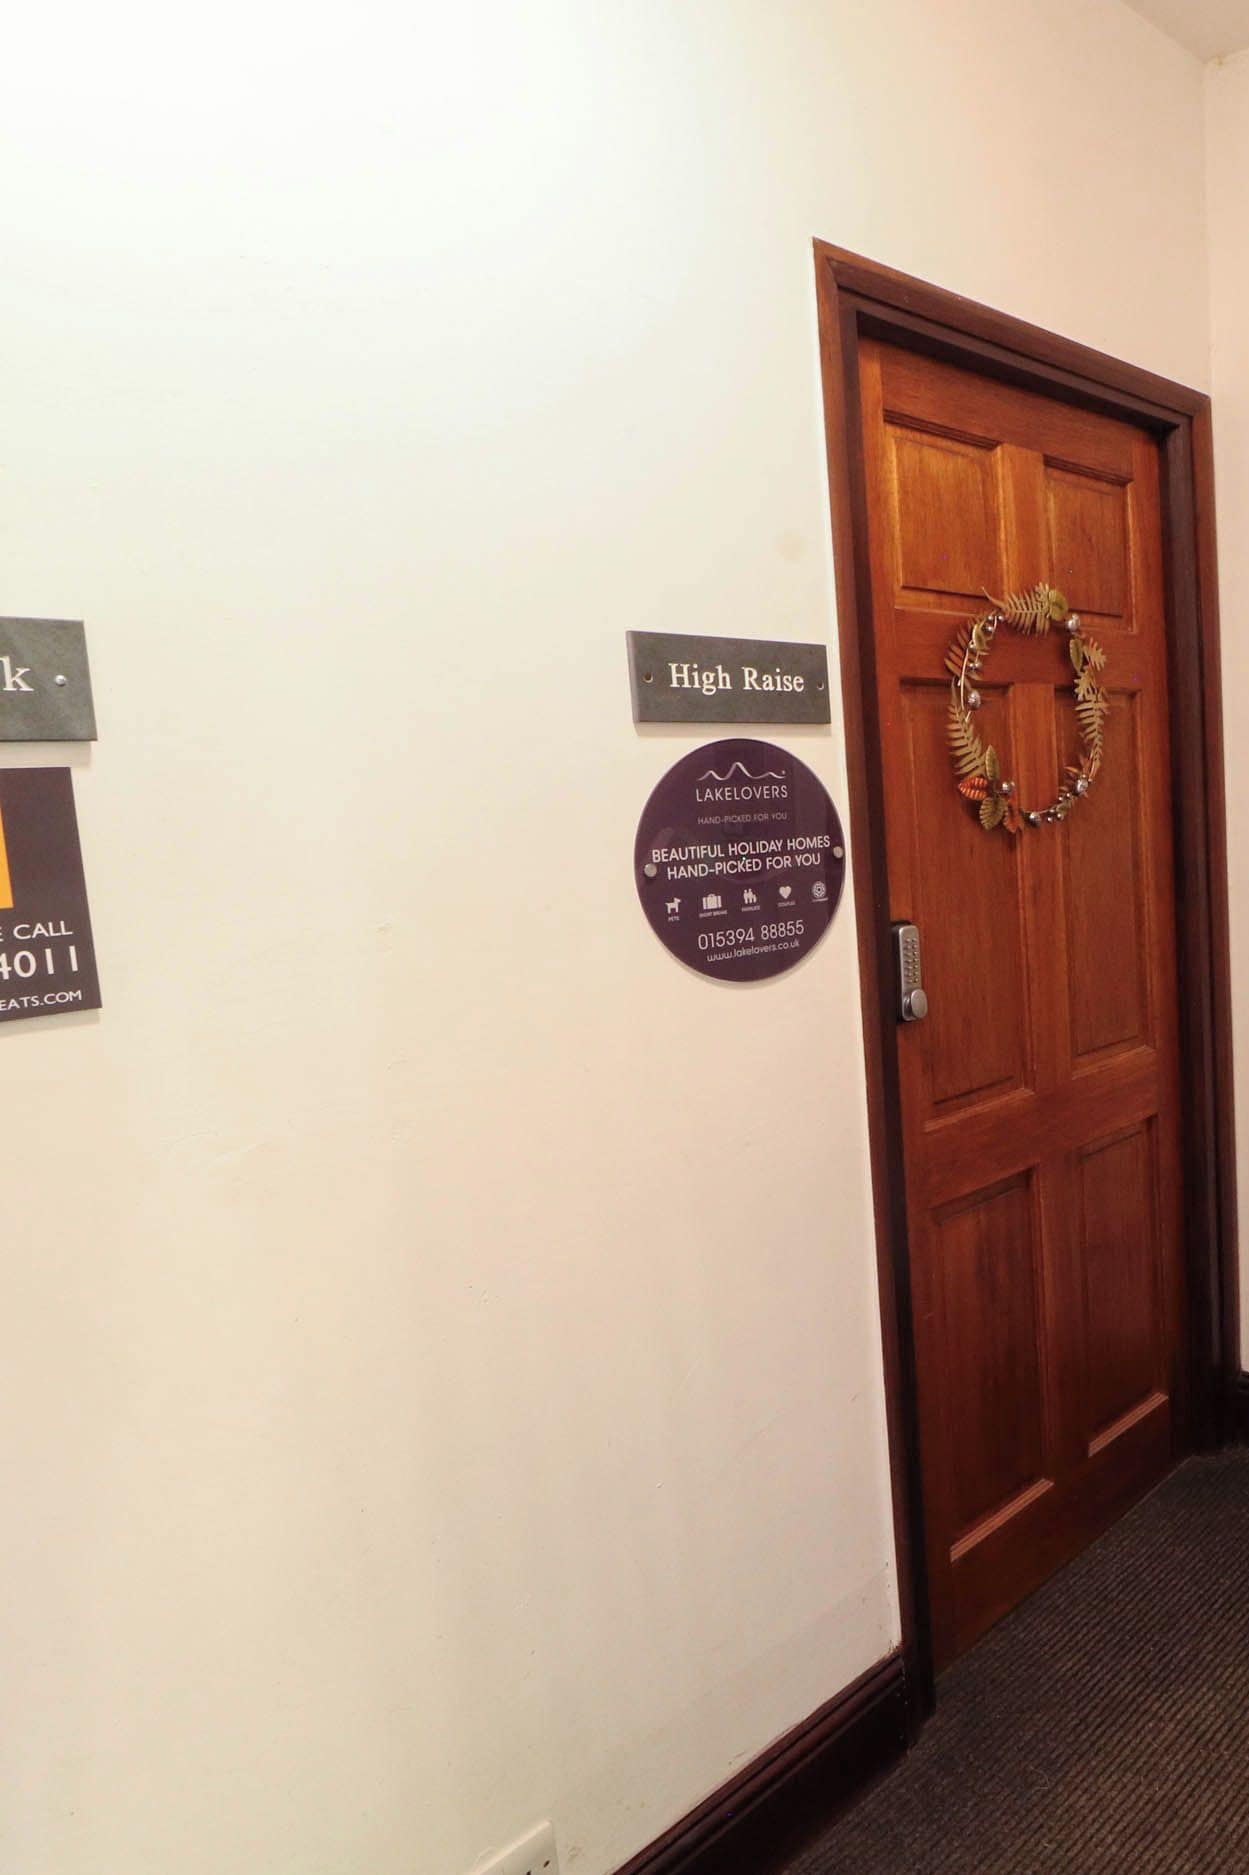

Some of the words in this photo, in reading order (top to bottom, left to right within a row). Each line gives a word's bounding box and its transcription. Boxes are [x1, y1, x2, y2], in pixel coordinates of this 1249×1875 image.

[668, 662, 733, 696] High
[741, 666, 805, 693] Raise
[695, 784, 788, 802] LAKELOVERS
[697, 813, 751, 825] HAND-PICKED
[753, 812, 769, 821] FOR
[772, 811, 788, 821] YOU
[652, 844, 725, 863] BEAUTIFUL
[728, 839, 783, 857] HOLIDAY
[786, 834, 831, 850] HOMES
[667, 858, 762, 881] HAND-PICKED
[766, 855, 792, 870] FOR
[794, 852, 821, 867] YOU
[13, 920, 74, 940] CALL
[698, 927, 755, 951] 015394
[760, 919, 805, 941] 88855
[706, 939, 800, 962] www.lakelovers.co.uk
